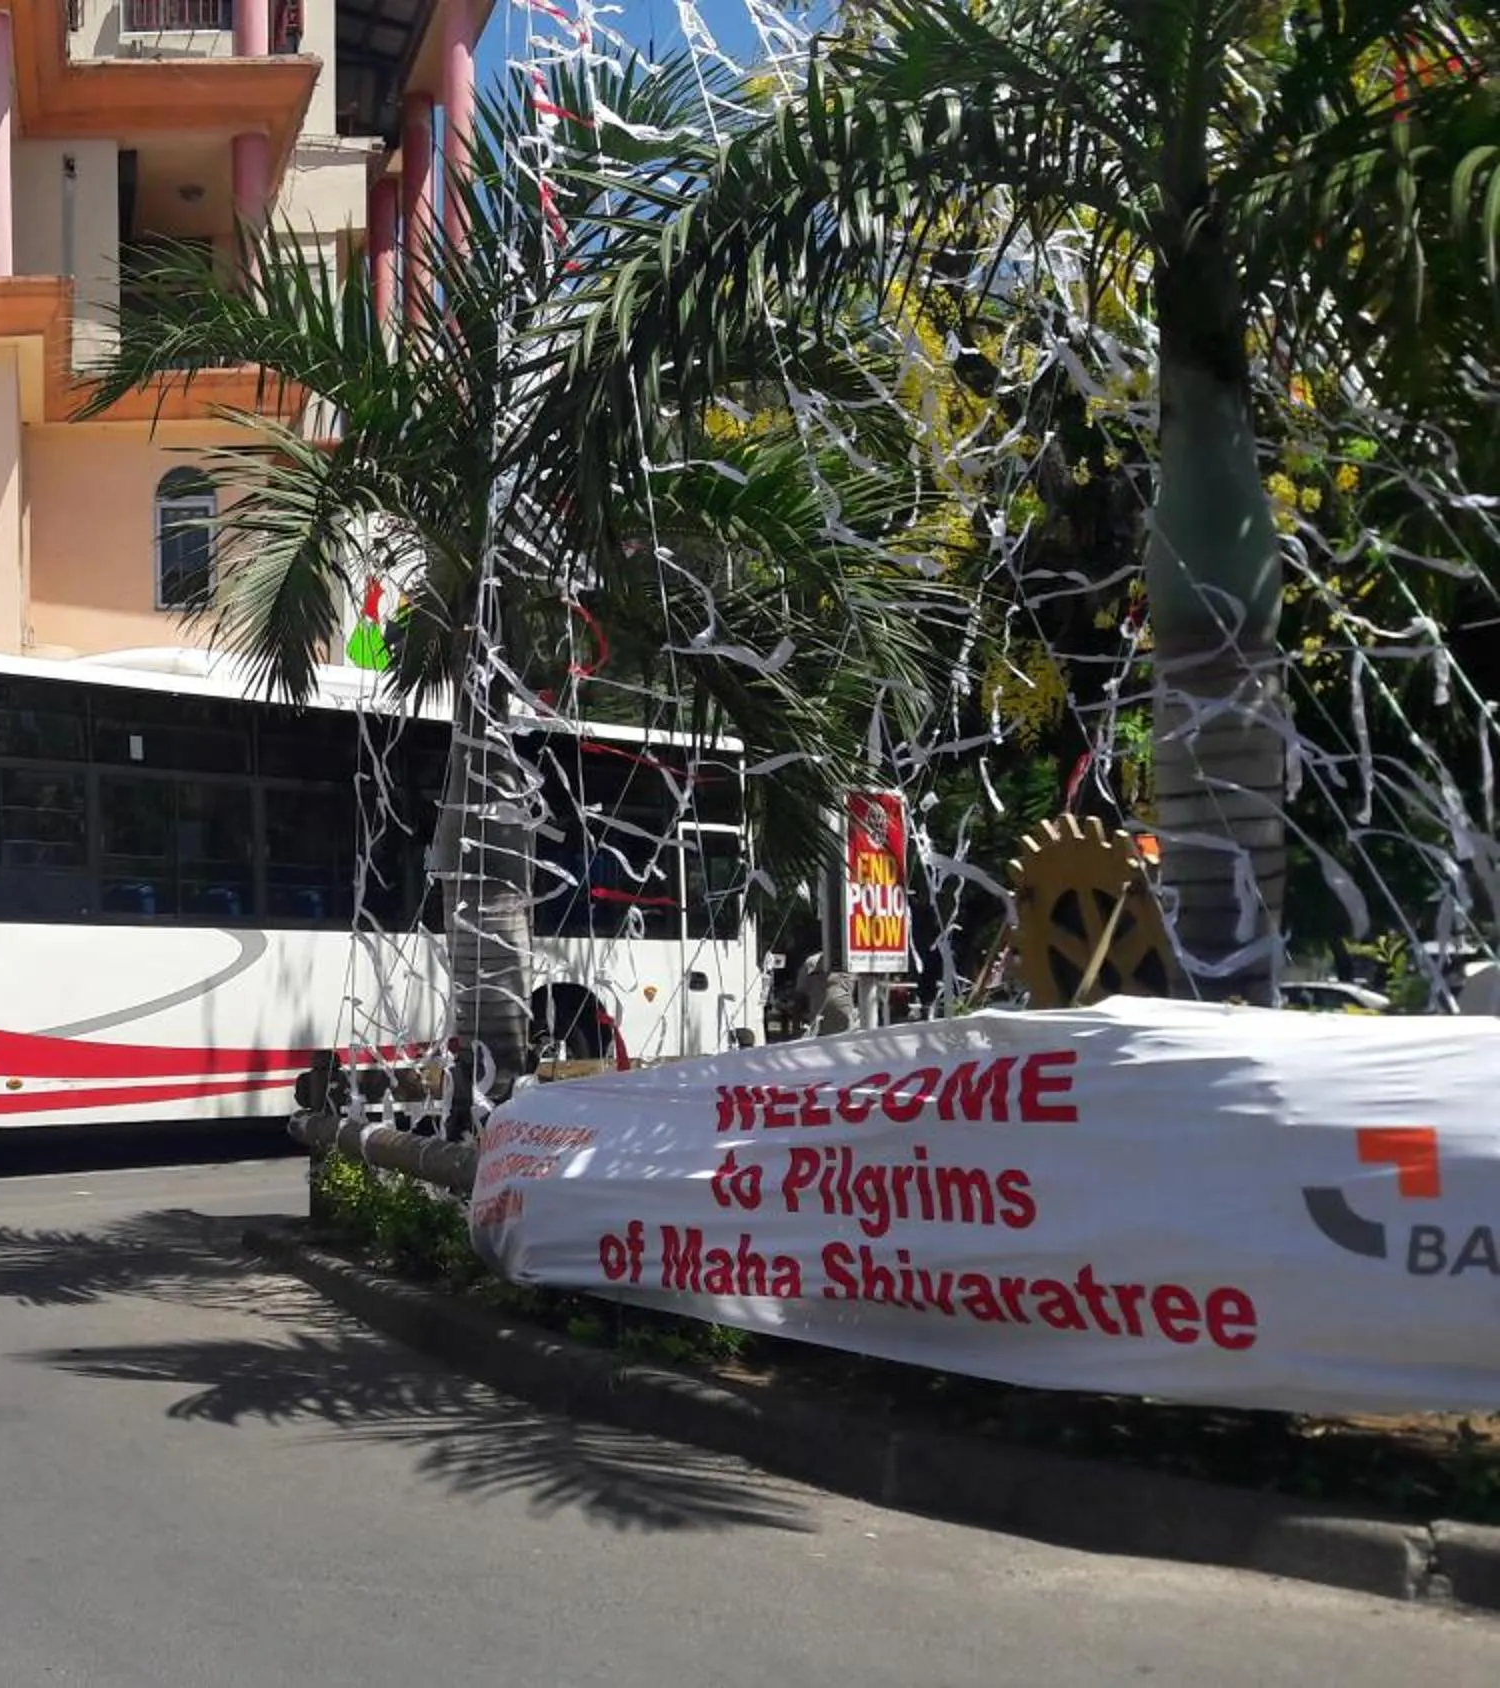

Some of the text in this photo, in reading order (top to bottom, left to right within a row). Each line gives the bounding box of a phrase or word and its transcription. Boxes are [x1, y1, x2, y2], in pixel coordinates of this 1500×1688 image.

[857, 853, 897, 885] END
[848, 884, 905, 916] POLIO
[855, 915, 901, 947] NOW
[715, 1050, 1078, 1132] WELCOME
[710, 1145, 1037, 1238] to Pilgrims
[600, 1220, 1258, 1350] of Maha Shivaratree
